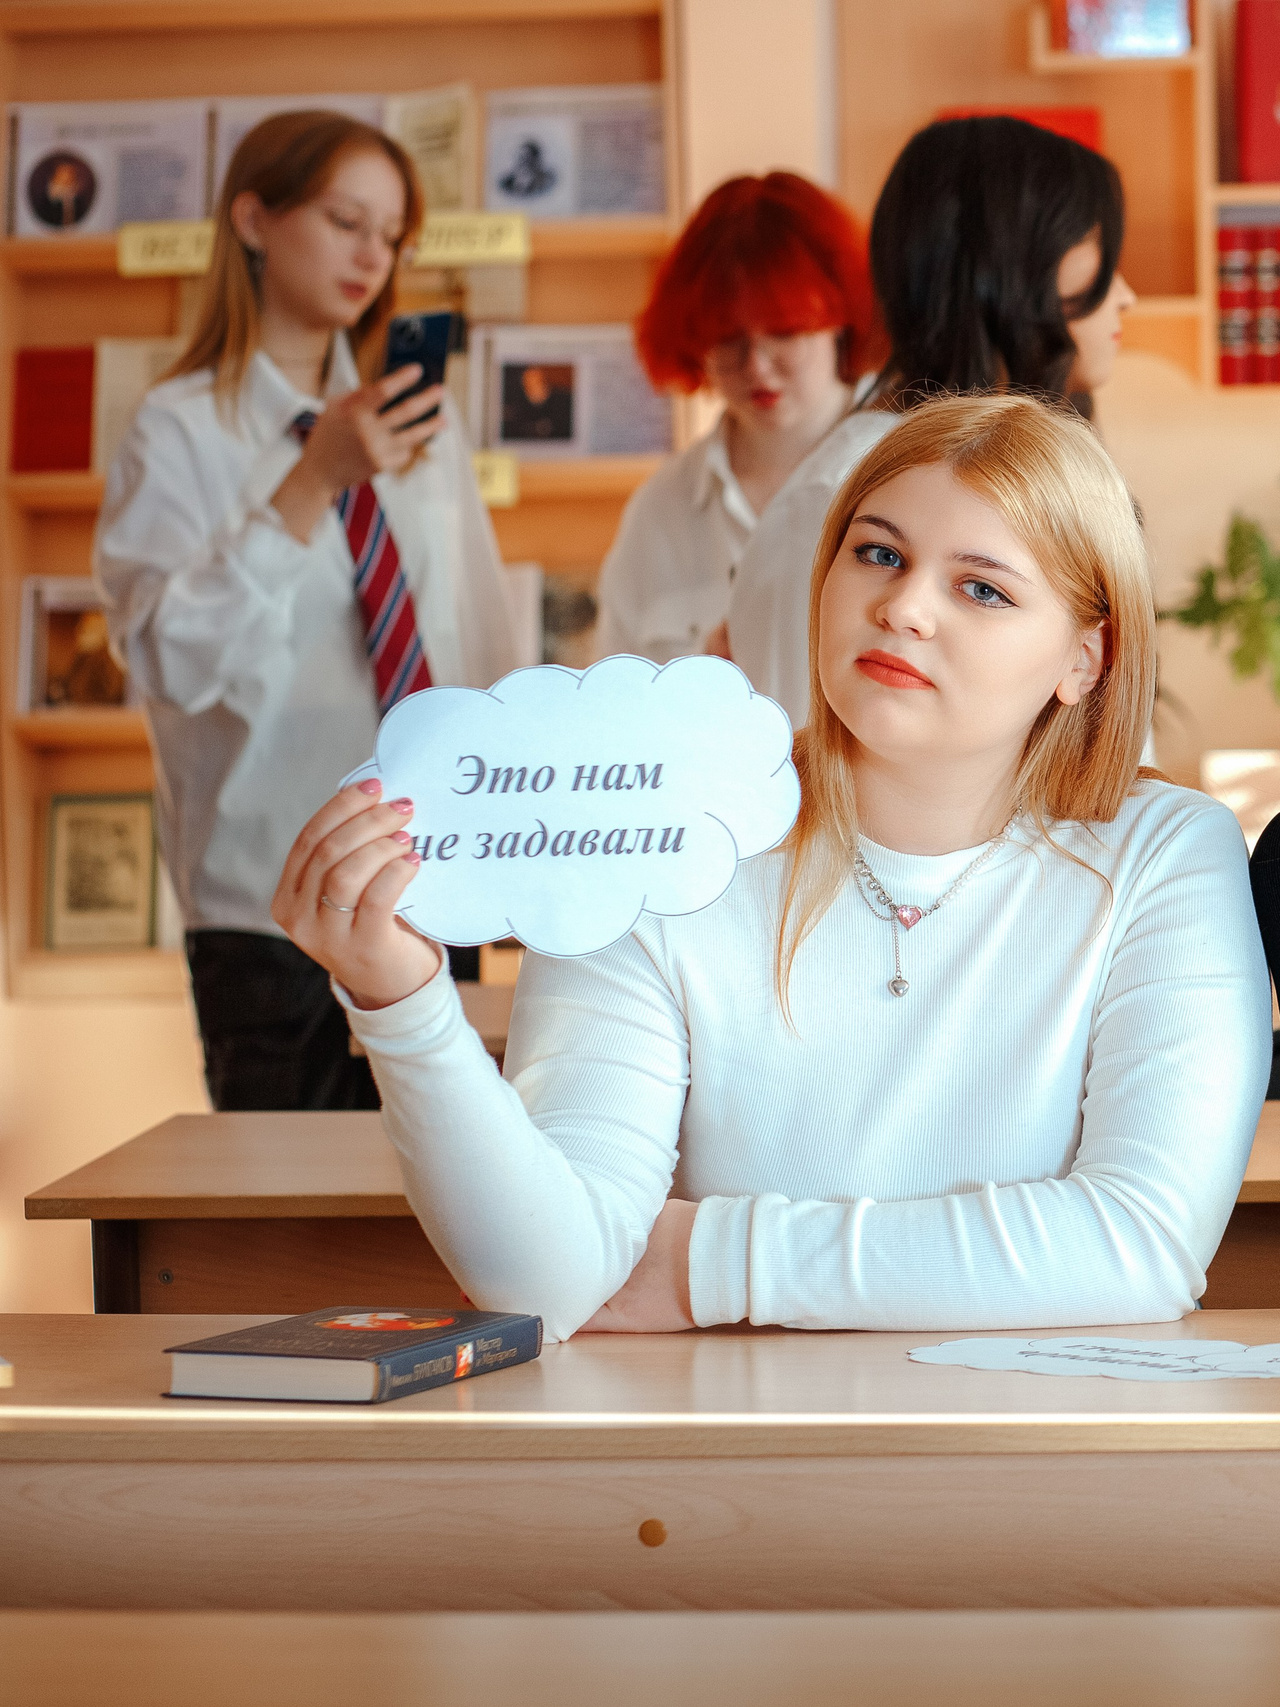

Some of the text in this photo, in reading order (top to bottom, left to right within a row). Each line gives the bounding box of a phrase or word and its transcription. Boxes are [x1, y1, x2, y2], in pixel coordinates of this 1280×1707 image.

[450, 754, 664, 795] Это нам
[411, 818, 686, 862] не задавали
